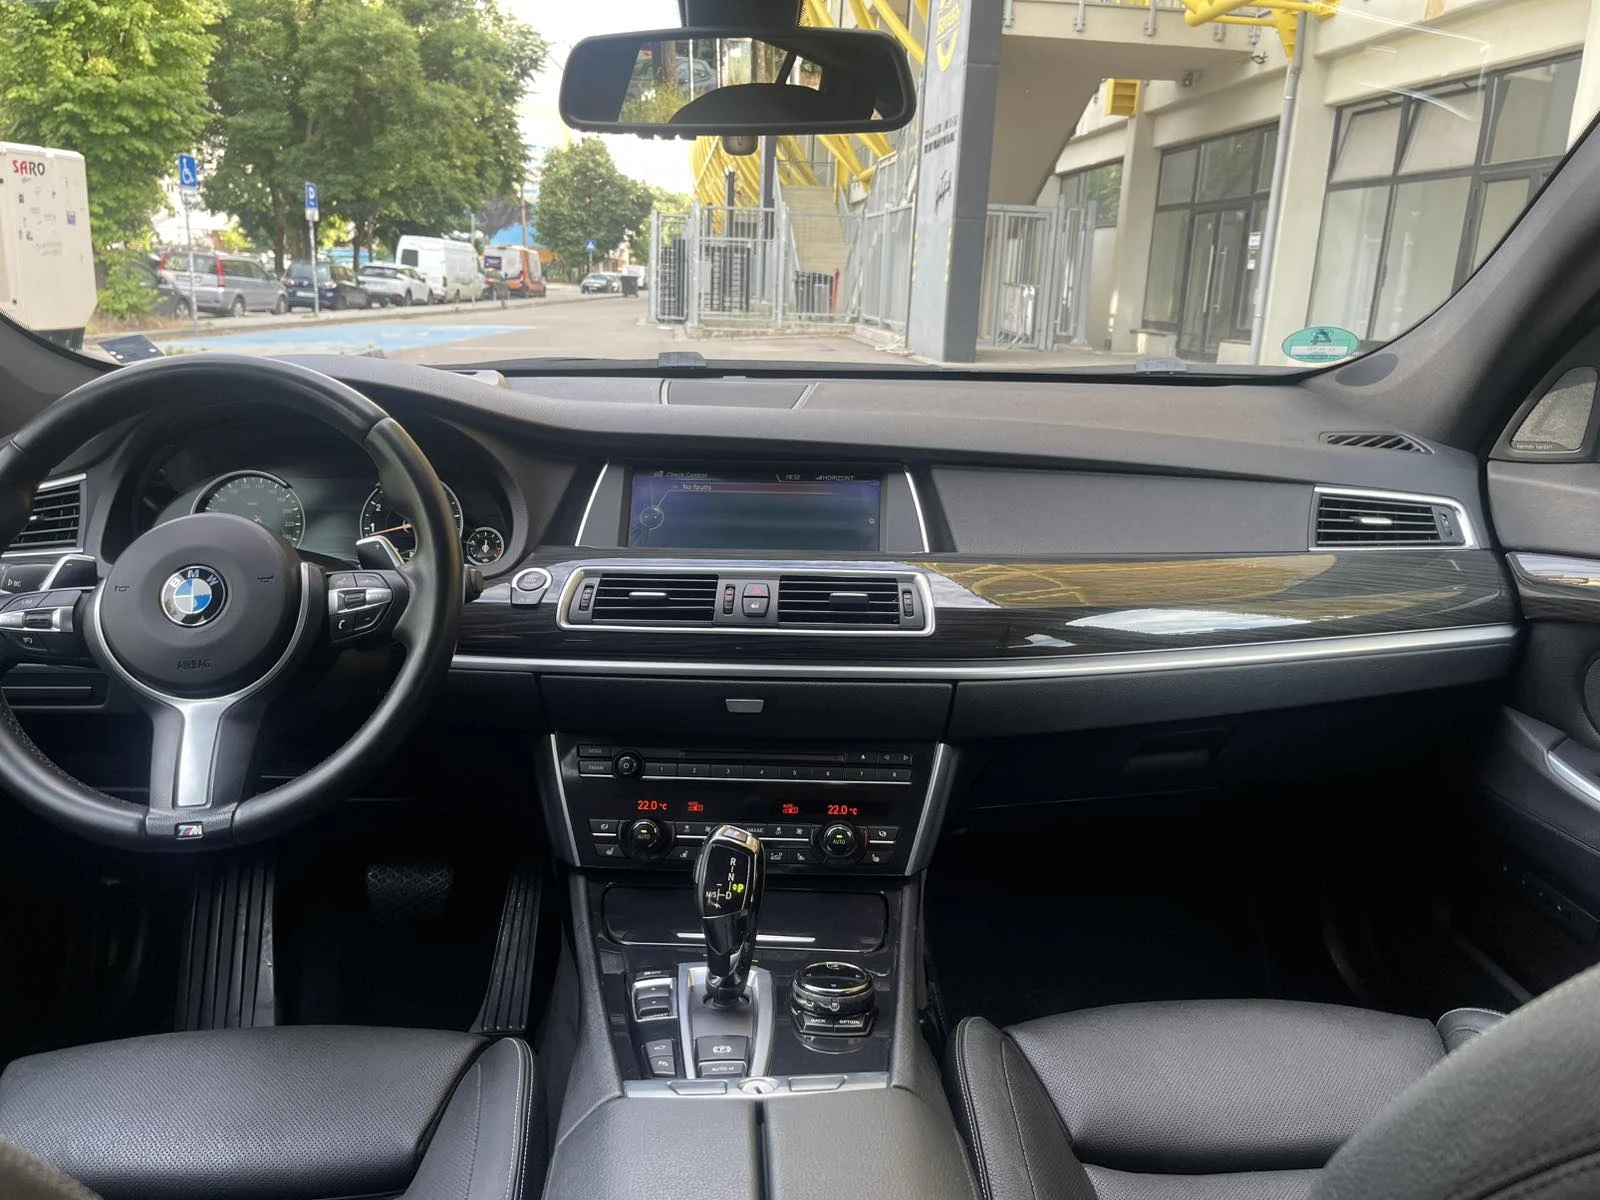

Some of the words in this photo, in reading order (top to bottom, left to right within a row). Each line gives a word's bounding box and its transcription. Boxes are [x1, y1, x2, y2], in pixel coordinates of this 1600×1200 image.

[12, 160, 46, 176] SARO
[308, 186, 315, 199] P
[370, 523, 375, 532] 1
[169, 569, 219, 588] BMW
[177, 660, 211, 670] AIRBAG
[637, 801, 657, 811] 22.0
[828, 805, 848, 815] 22.0
[730, 858, 736, 866] R
[728, 873, 734, 881] N
[737, 884, 744, 893] P
[725, 891, 732, 899] D
